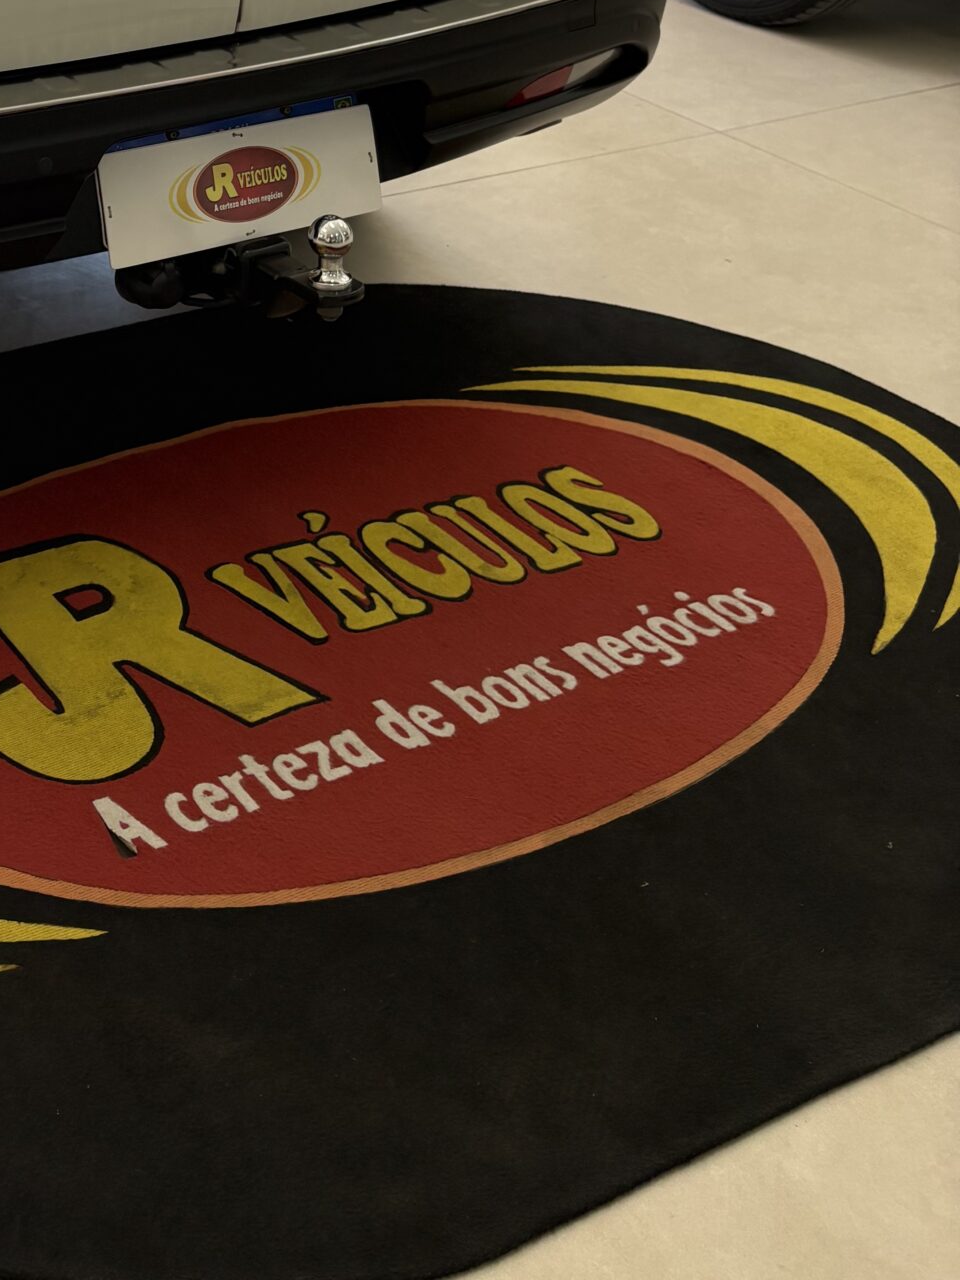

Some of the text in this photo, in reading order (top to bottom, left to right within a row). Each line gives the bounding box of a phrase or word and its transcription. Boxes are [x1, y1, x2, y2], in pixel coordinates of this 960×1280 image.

[205, 162, 288, 202] JR VEÍCULOS
[219, 201, 240, 211] certeza
[240, 198, 247, 206] de
[248, 196, 260, 205] bons
[92, 587, 776, 856] A certeza de bons negócios
